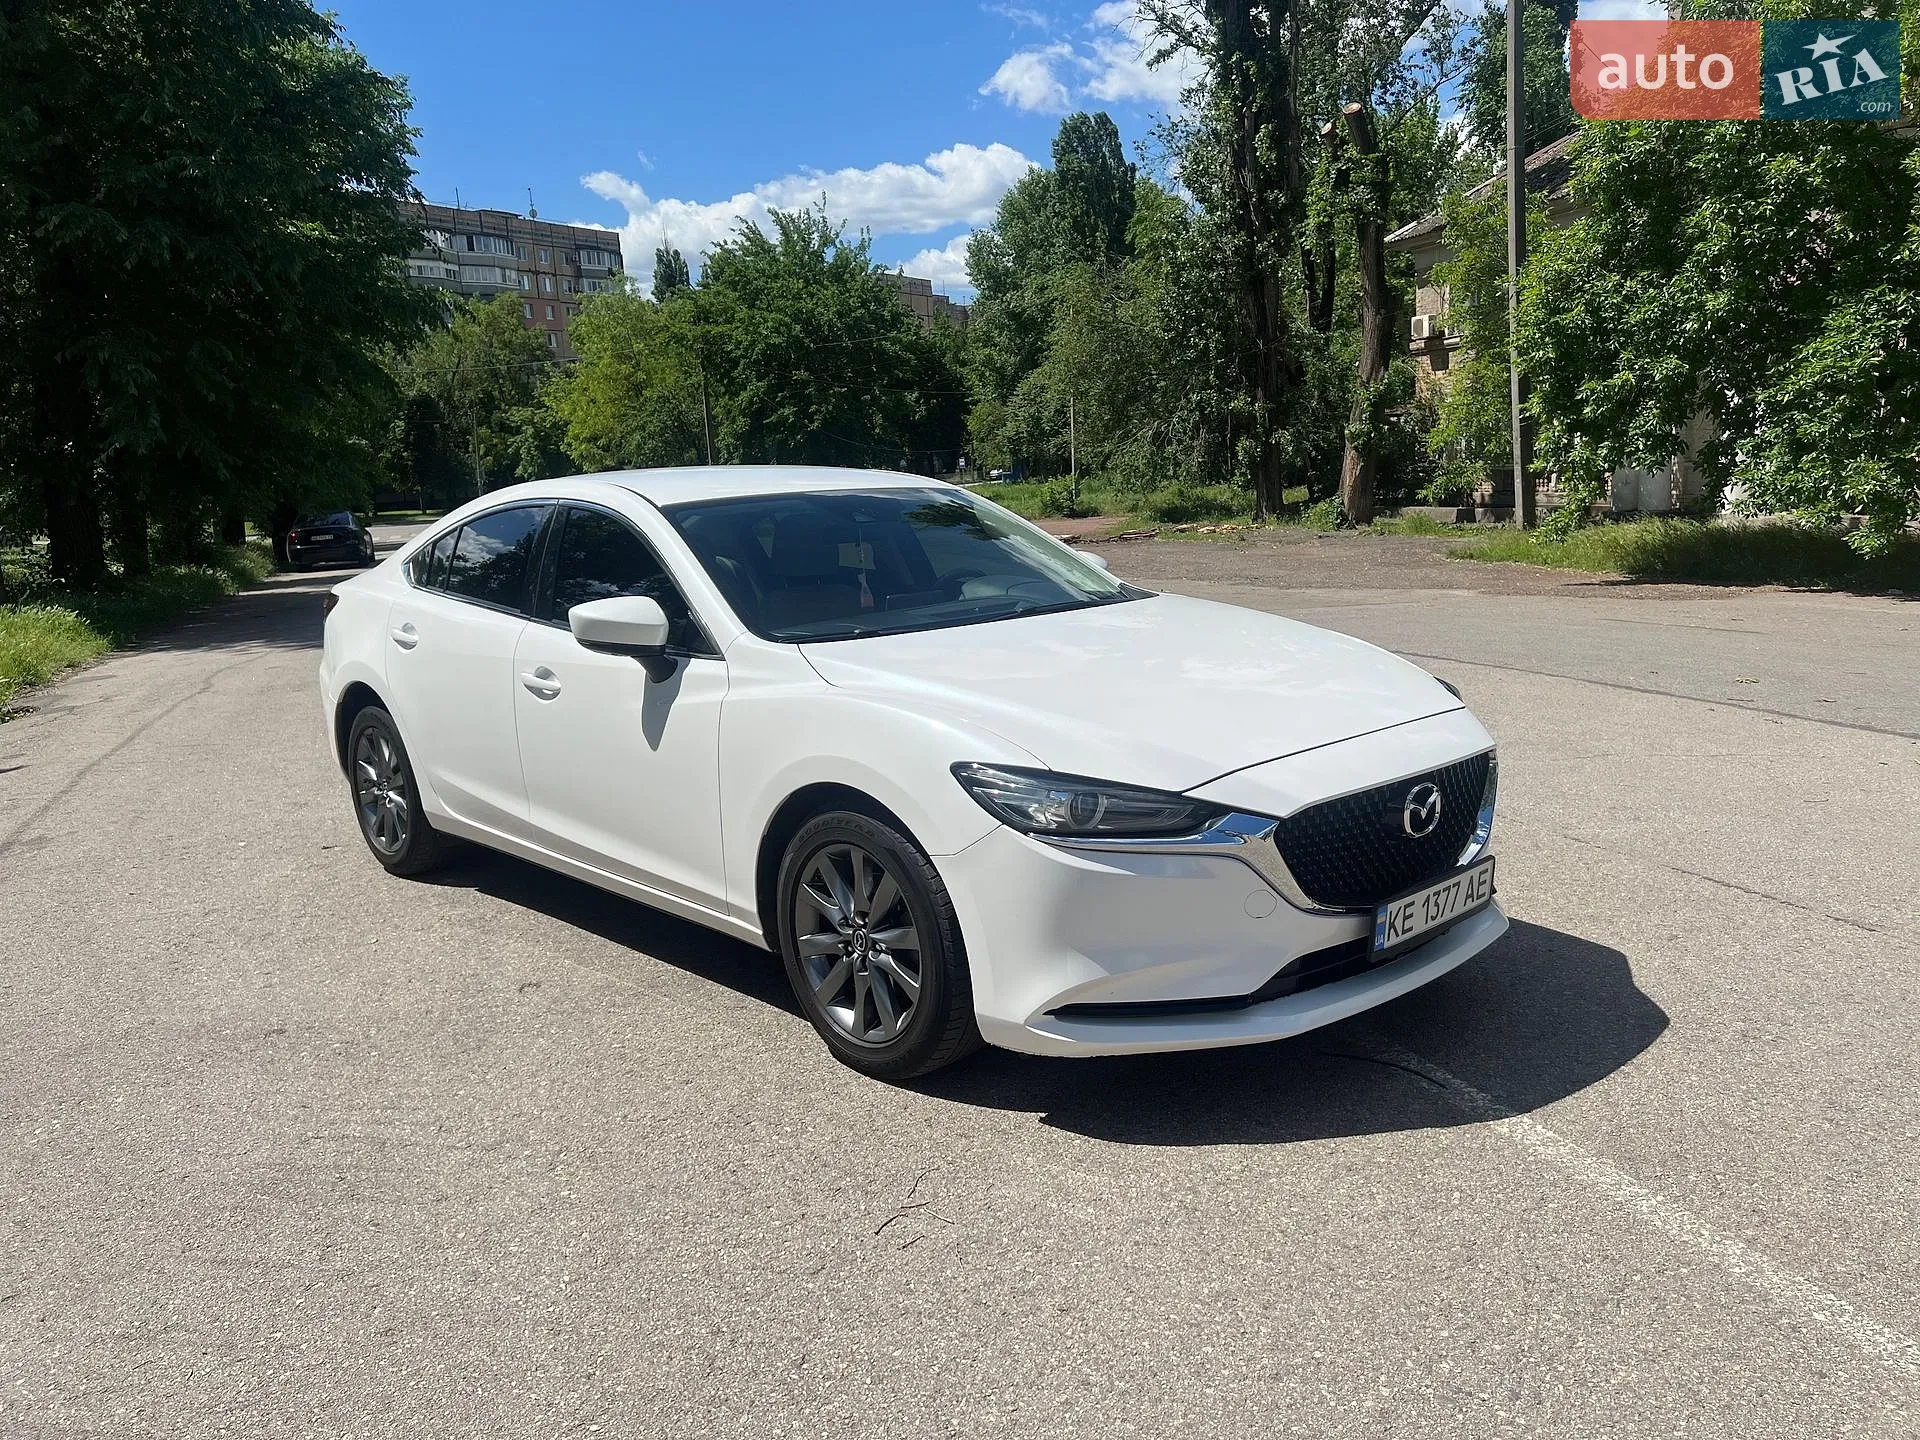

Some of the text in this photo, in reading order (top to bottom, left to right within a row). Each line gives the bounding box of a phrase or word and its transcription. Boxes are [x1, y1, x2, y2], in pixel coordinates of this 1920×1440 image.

[1387, 868, 1489, 942] KE 1377 AE
[1375, 935, 1384, 945] UA
